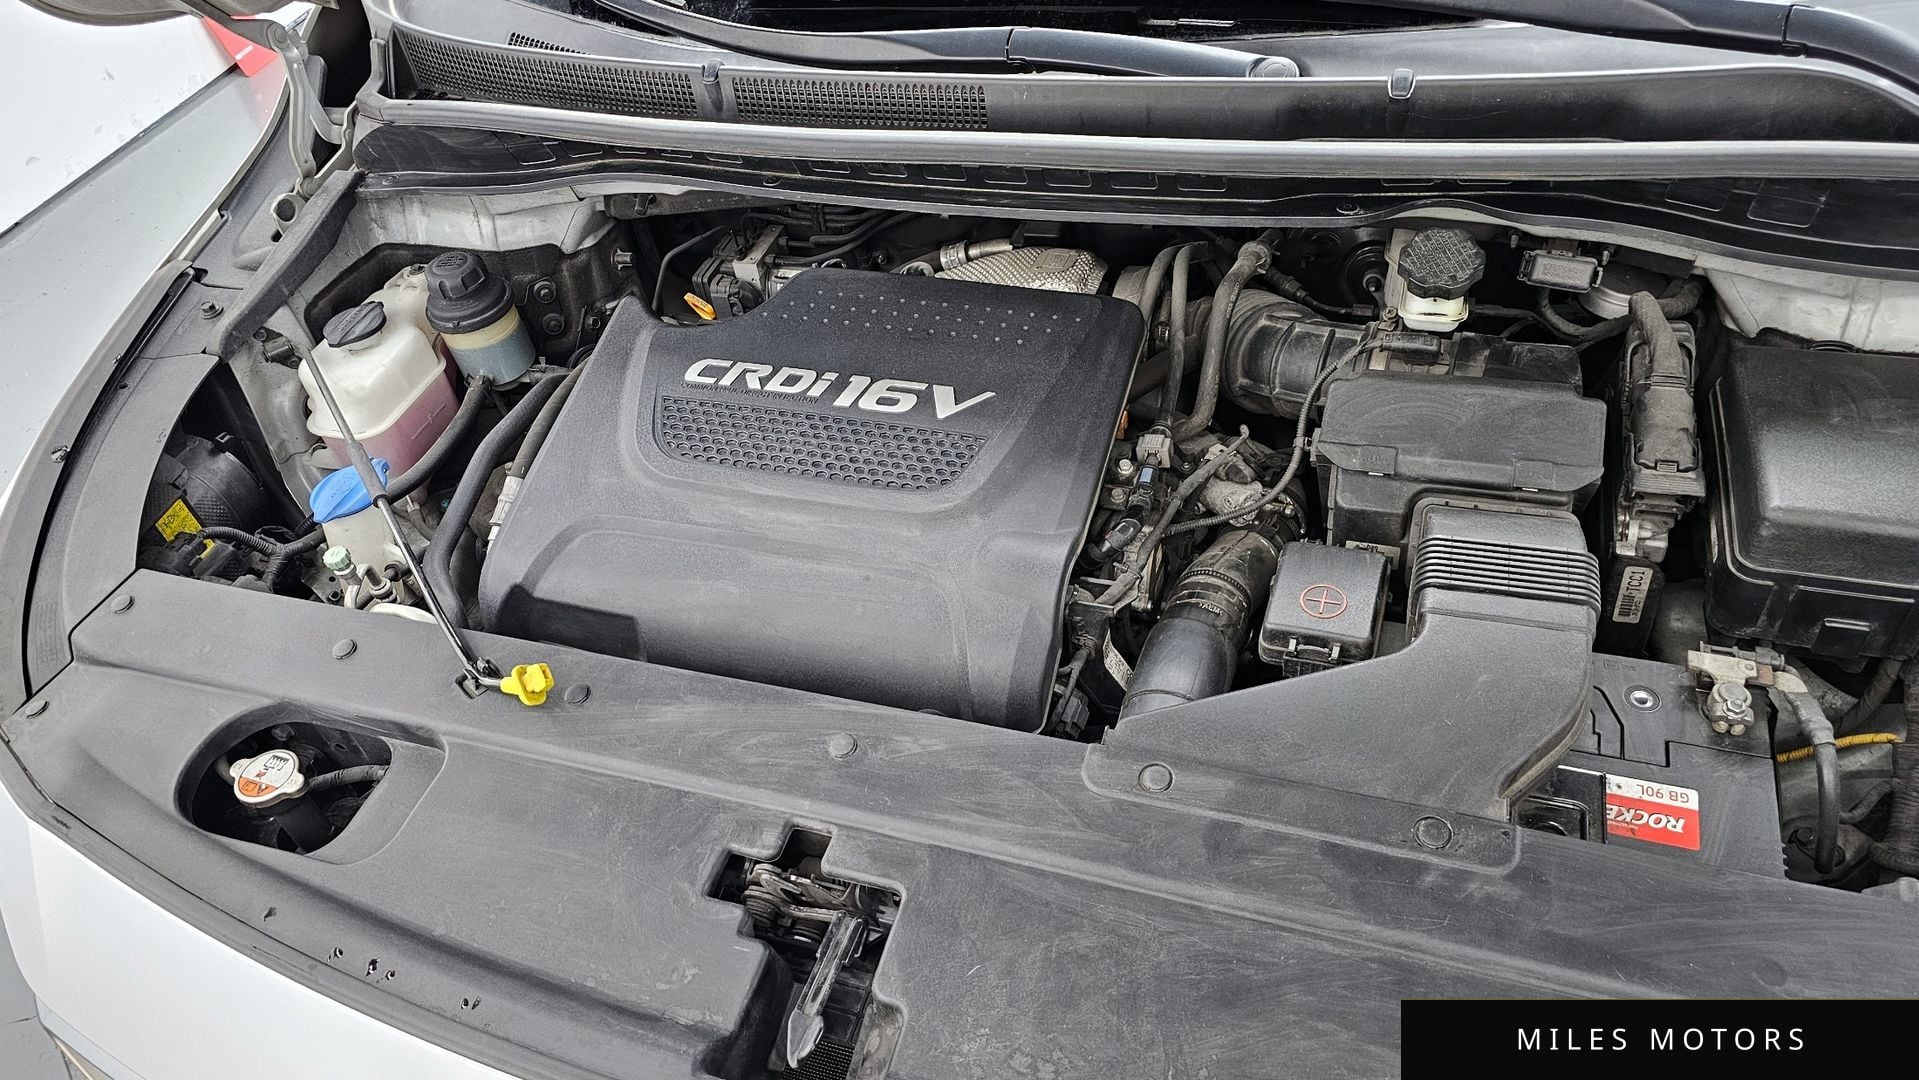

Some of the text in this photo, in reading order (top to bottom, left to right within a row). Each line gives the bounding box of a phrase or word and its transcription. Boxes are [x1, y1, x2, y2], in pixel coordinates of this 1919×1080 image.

[684, 358, 997, 419] CRDi 16V
[1626, 571, 1645, 591] TCC1
[1637, 784, 1689, 803] GB 90L
